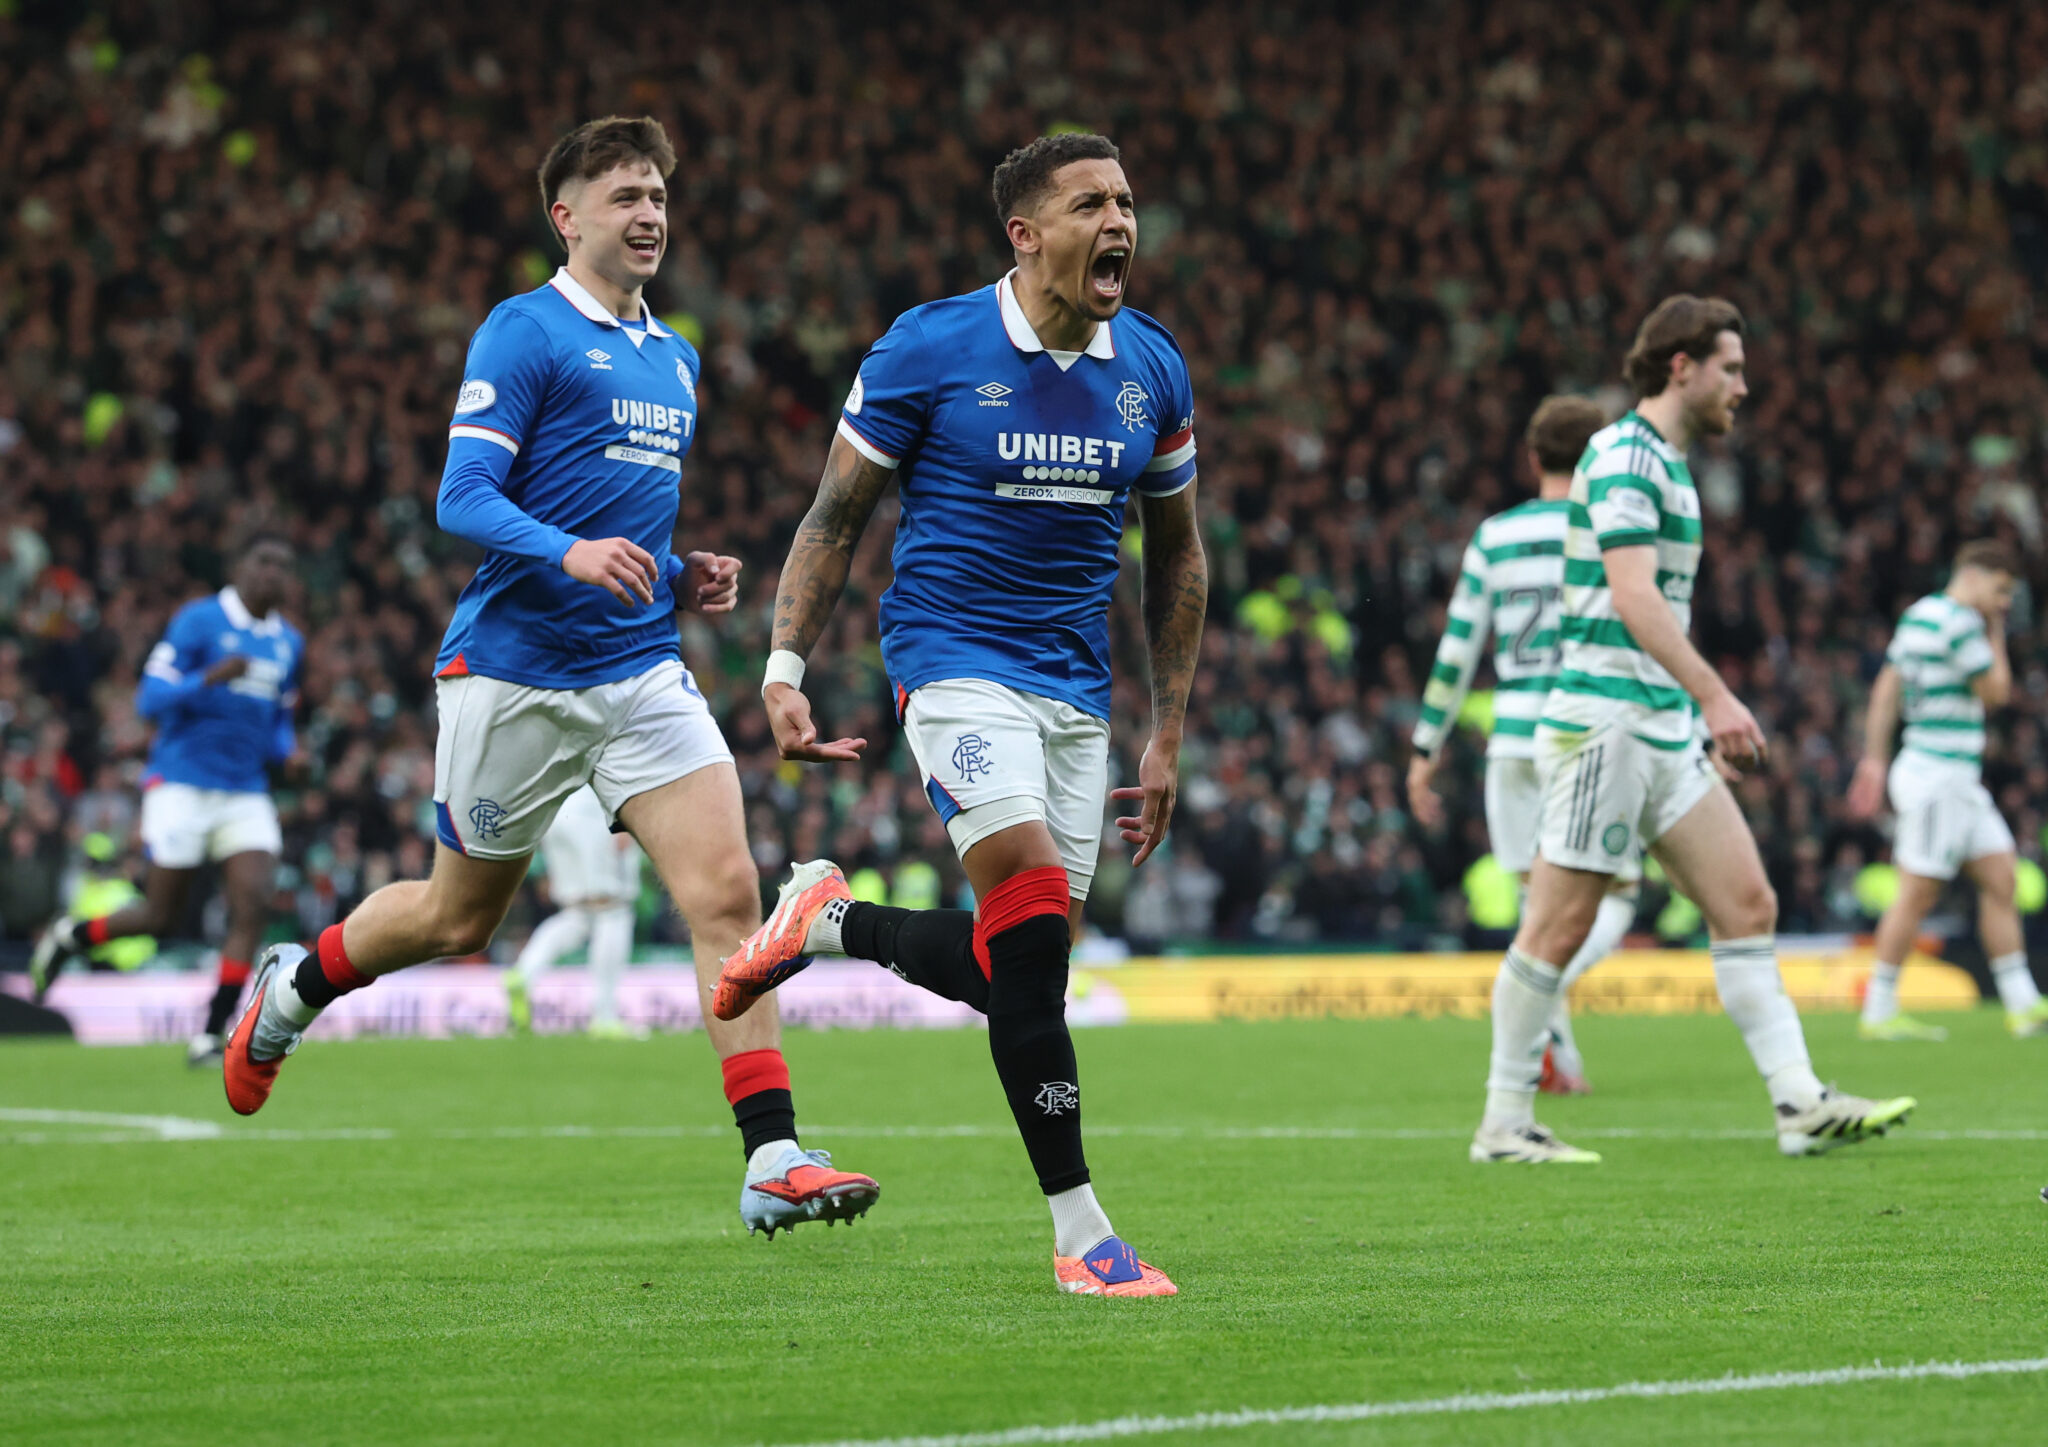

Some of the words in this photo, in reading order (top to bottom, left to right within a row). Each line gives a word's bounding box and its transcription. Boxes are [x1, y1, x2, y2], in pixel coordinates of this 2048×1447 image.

[978, 399, 1009, 408] umbro
[611, 398, 693, 438] UNIBET
[620, 448, 649, 463] ZERO%
[998, 432, 1126, 468] UNIBET
[1013, 487, 1054, 499] ZERO%
[1057, 489, 1100, 502] MISSION
